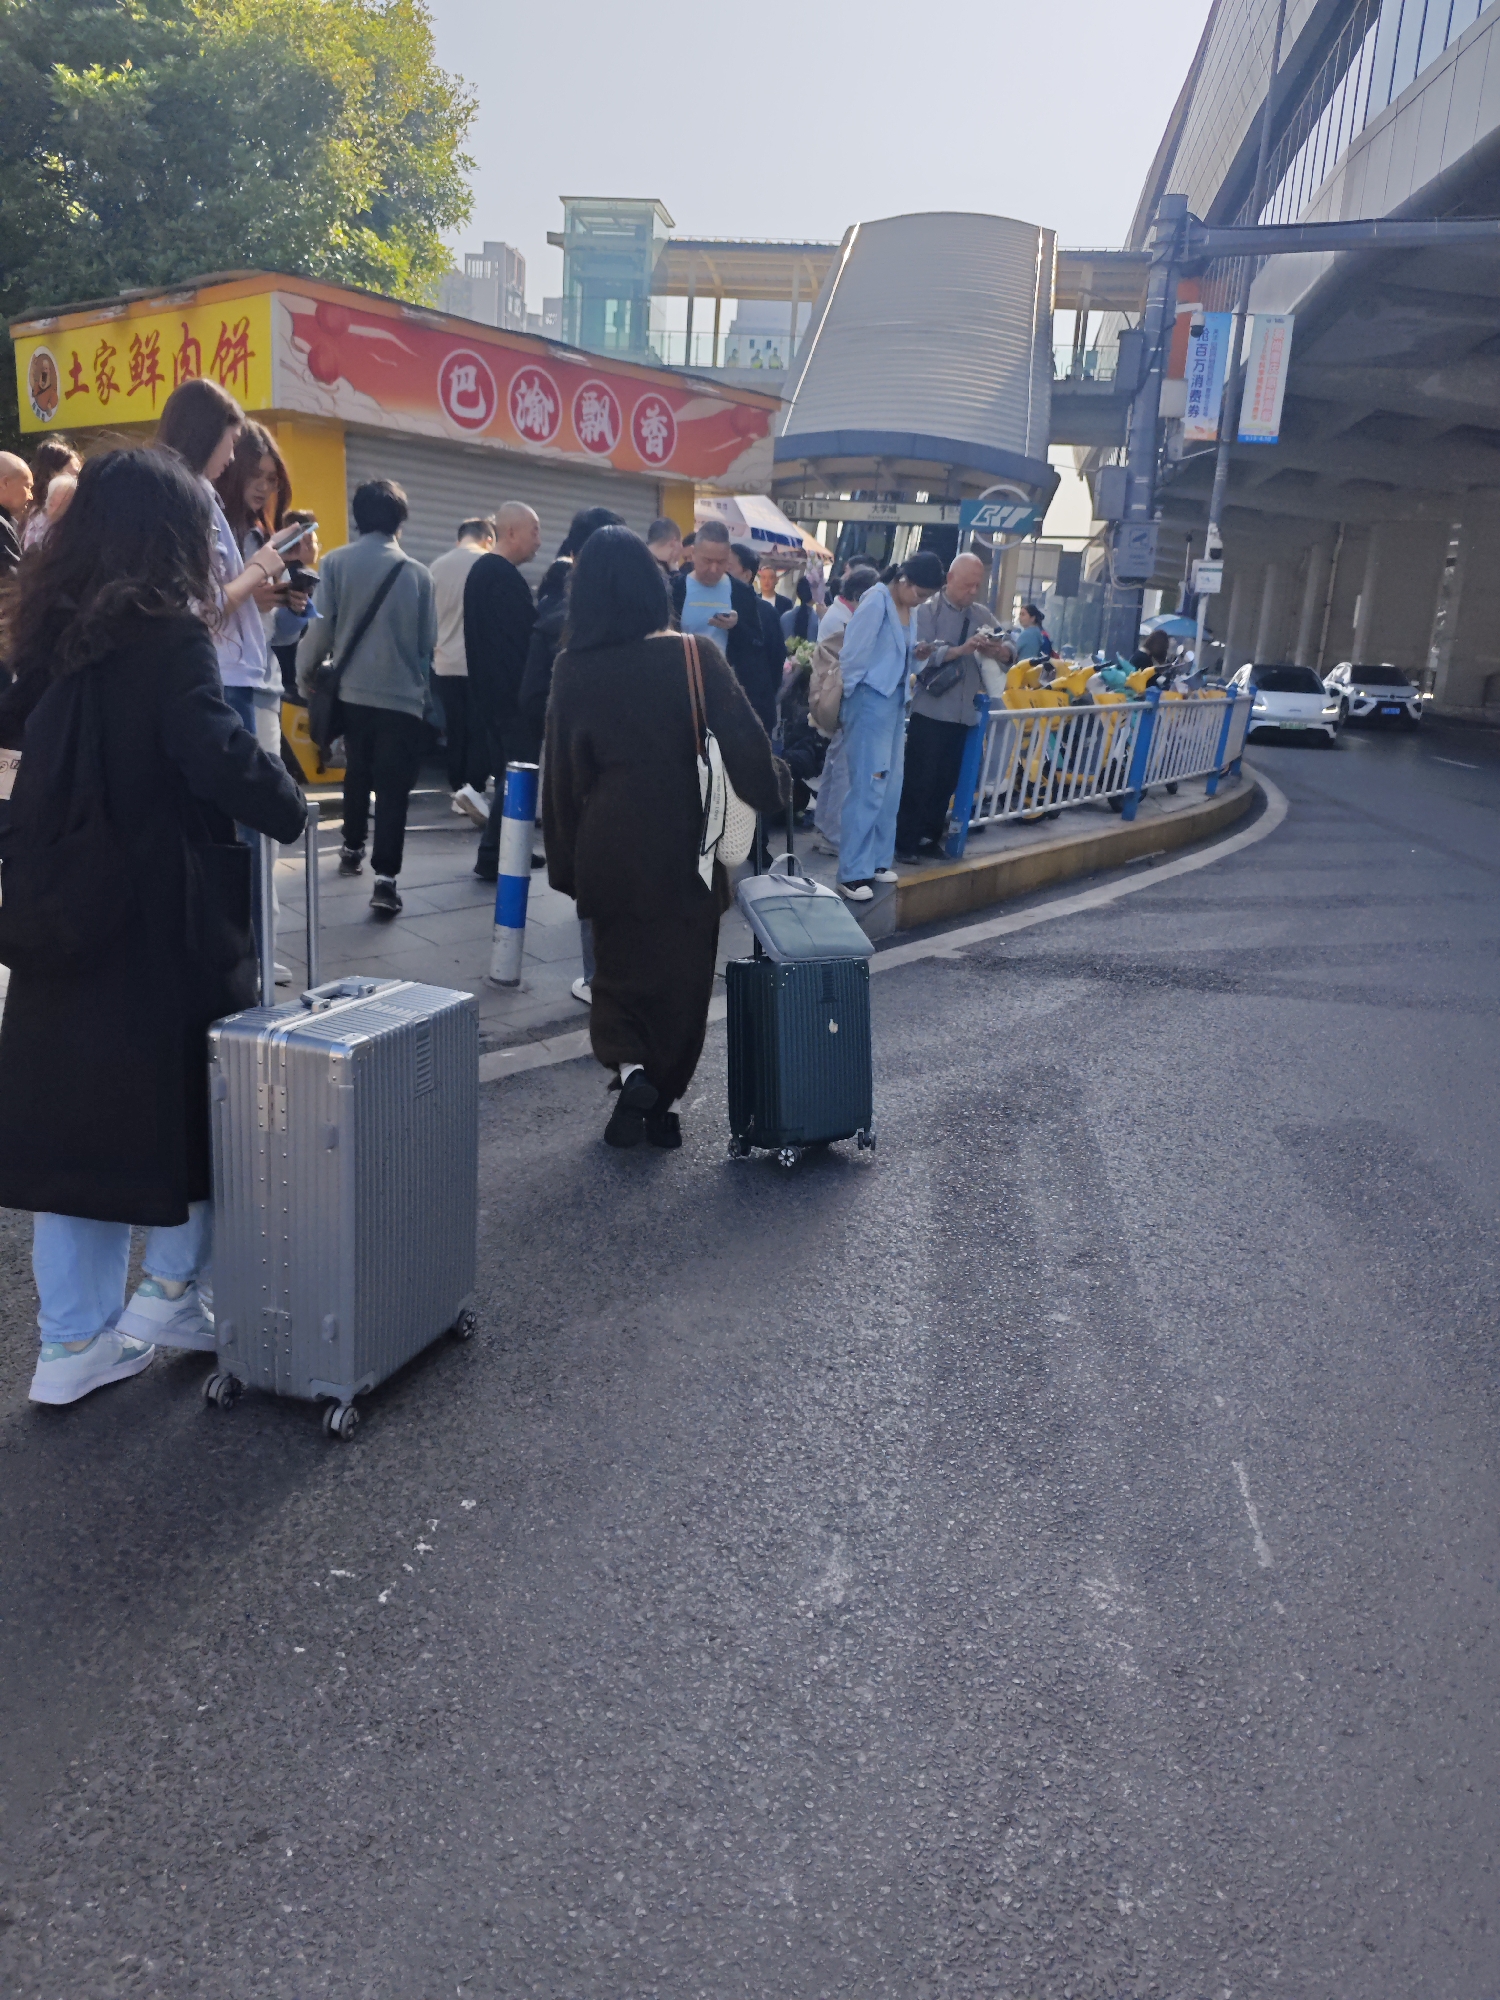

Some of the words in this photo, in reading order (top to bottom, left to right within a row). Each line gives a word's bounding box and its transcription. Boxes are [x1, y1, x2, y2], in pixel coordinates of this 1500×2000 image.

[64, 315, 256, 411] 土家鲜肉饼
[449, 364, 670, 458] 巴渝飘香
